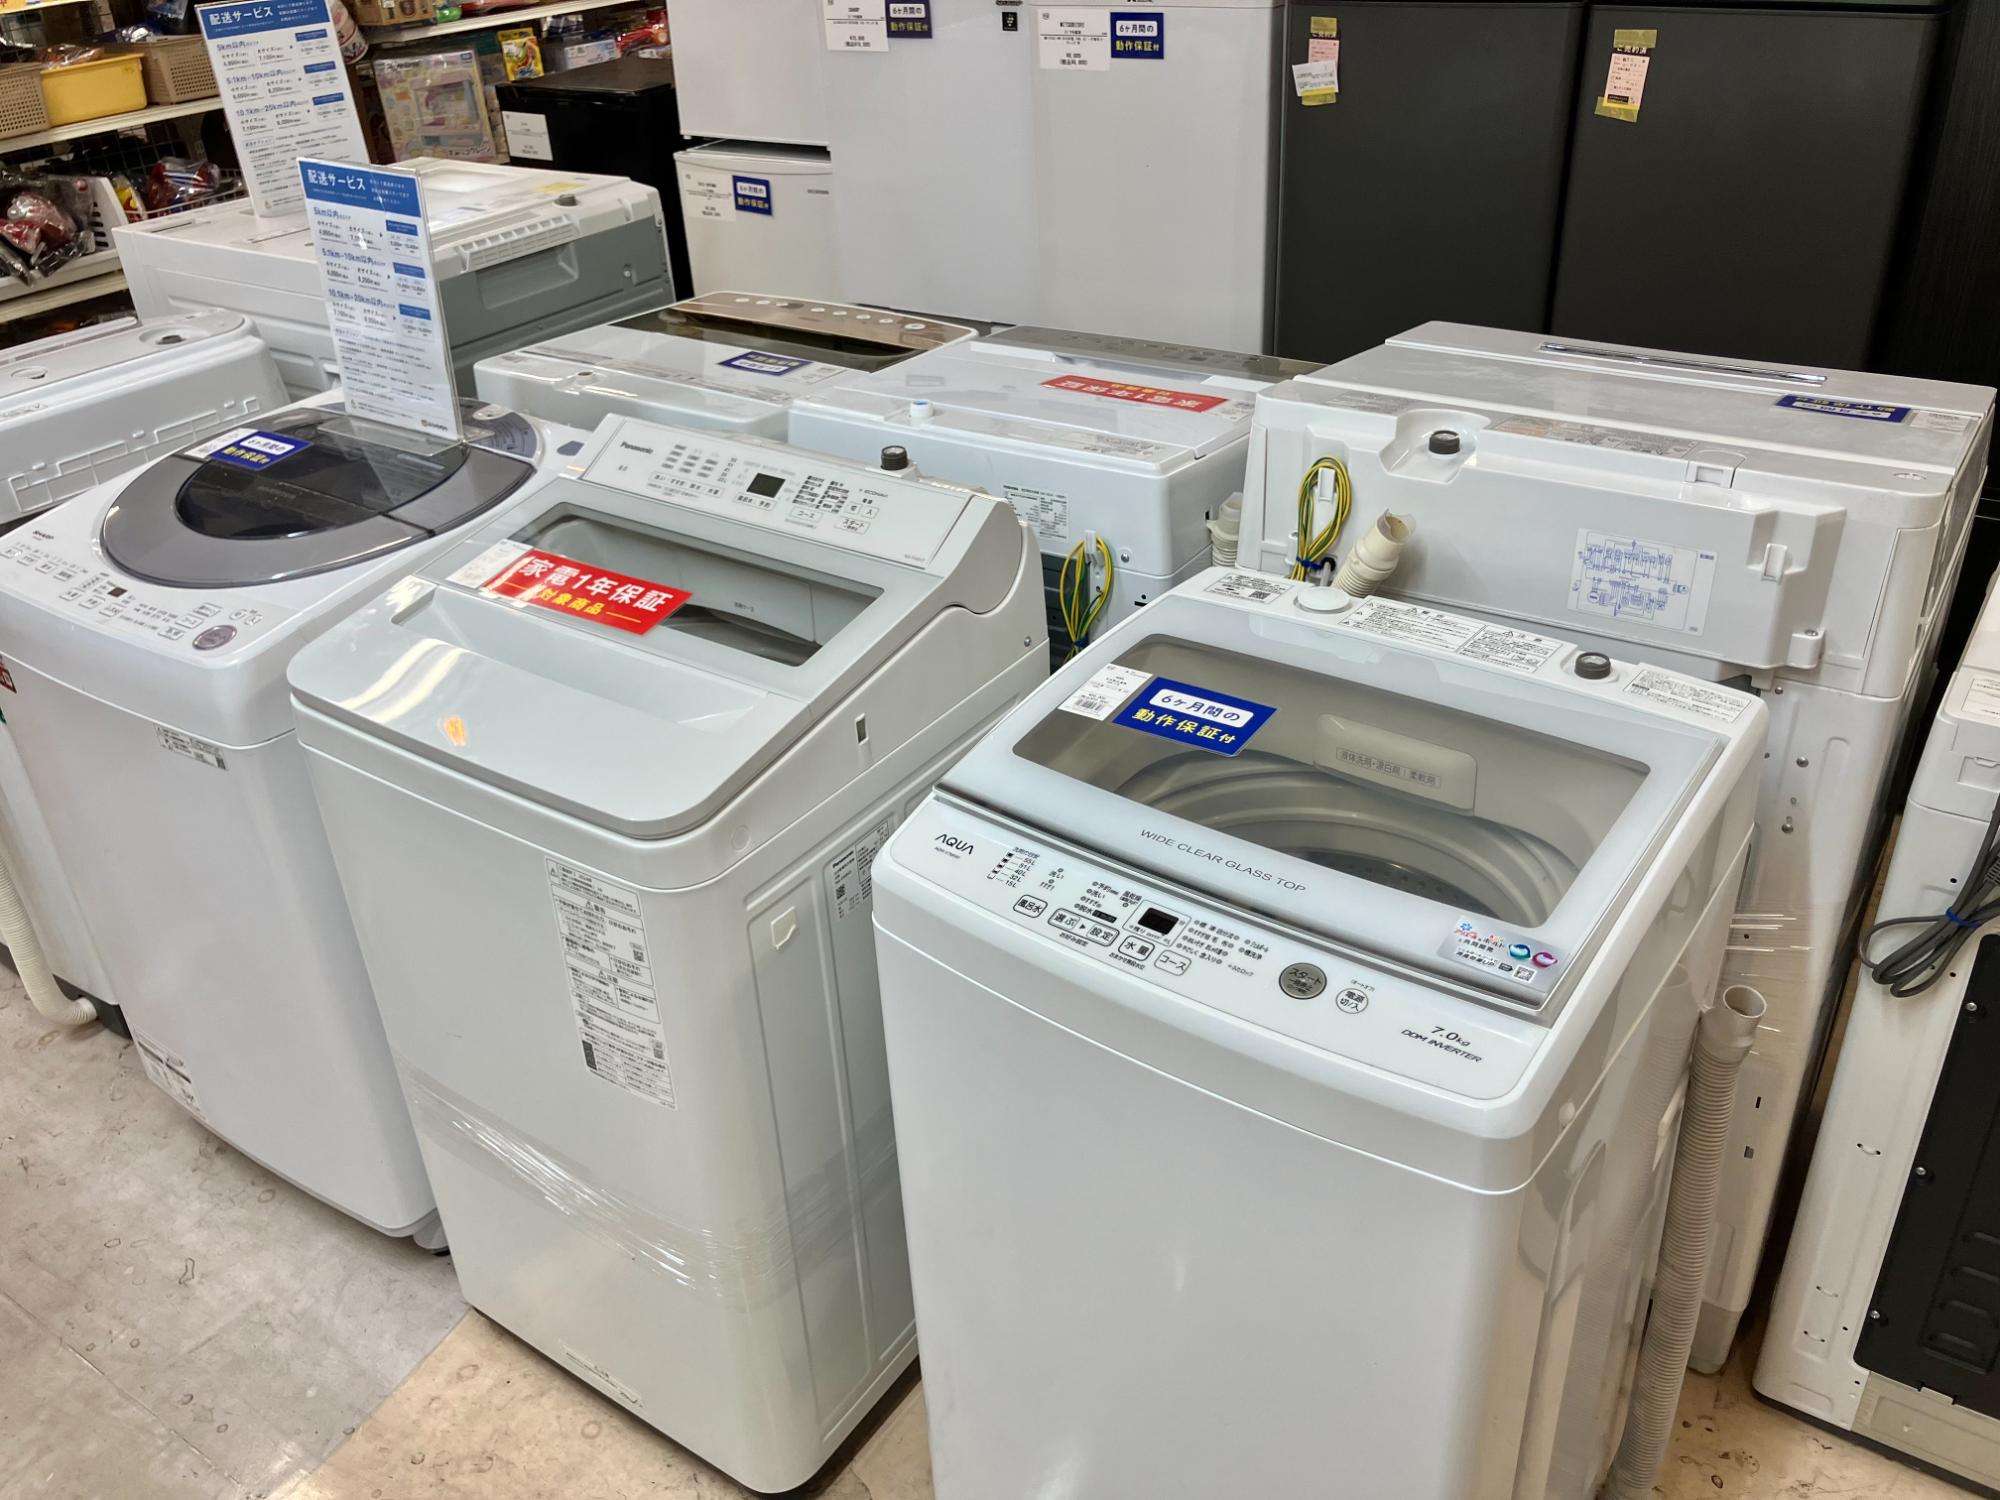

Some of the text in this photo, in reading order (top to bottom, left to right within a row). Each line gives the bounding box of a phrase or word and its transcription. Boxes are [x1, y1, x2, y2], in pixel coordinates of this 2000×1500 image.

[208, 6, 274, 26] 配送サービス
[1115, 40, 1160, 51] 動作保証付
[307, 169, 366, 191] 配送サービス
[620, 441, 654, 455] Panasonic
[519, 557, 674, 613] 家電1年保証
[536, 588, 605, 616] 対象商品
[1131, 707, 1237, 745] 動作保証付
[934, 833, 975, 855] AQUA
[1140, 828, 1307, 893] WIDE CLEAR GLASS TOP
[1017, 899, 1042, 914] 風呂水
[1053, 912, 1114, 942] 選ぶ 設定
[1159, 954, 1187, 971] コース
[1288, 967, 1322, 985] スタート
[1345, 990, 1366, 1004] 電源
[1430, 1026, 1472, 1048] 7.0kg
[1427, 1039, 1483, 1063] INVERTER
